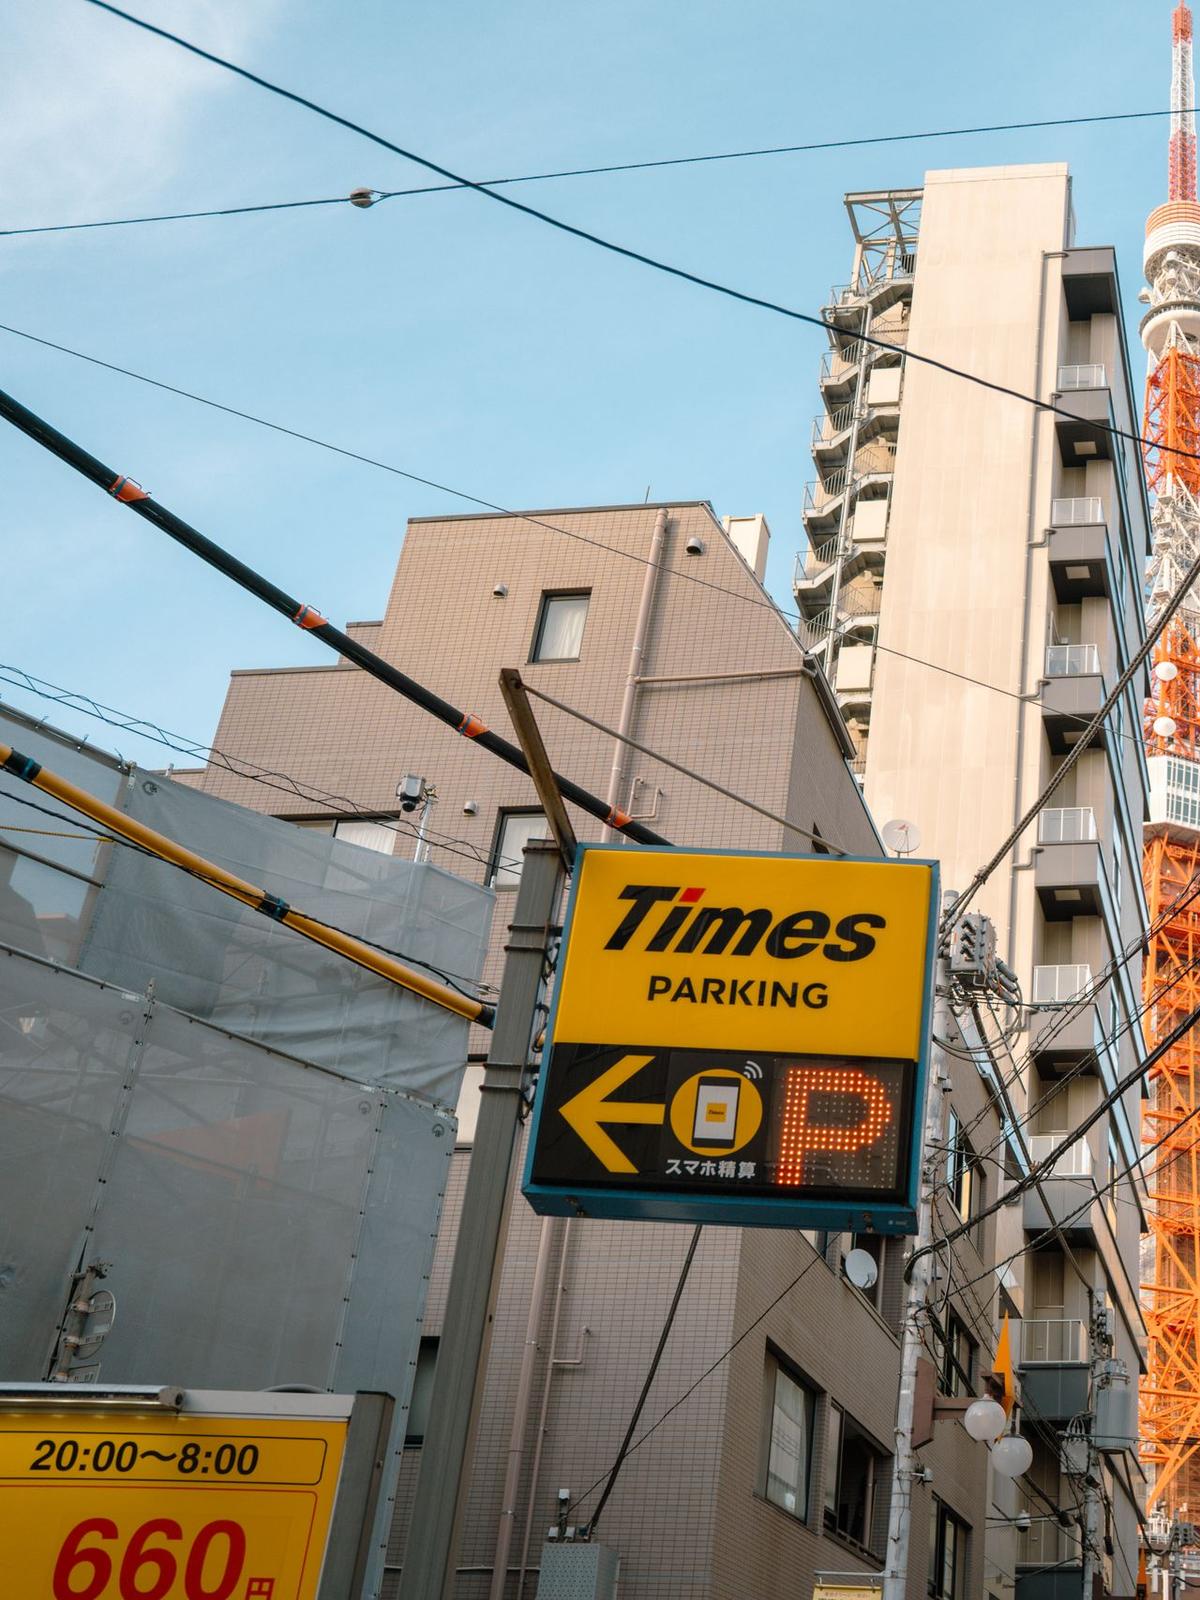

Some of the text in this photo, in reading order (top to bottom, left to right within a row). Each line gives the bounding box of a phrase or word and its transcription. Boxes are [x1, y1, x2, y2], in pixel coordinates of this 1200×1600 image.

[604, 885, 886, 962] Times
[647, 975, 829, 1009] PARKING
[776, 1066, 892, 1186] P
[665, 1159, 756, 1179] スマホ精算
